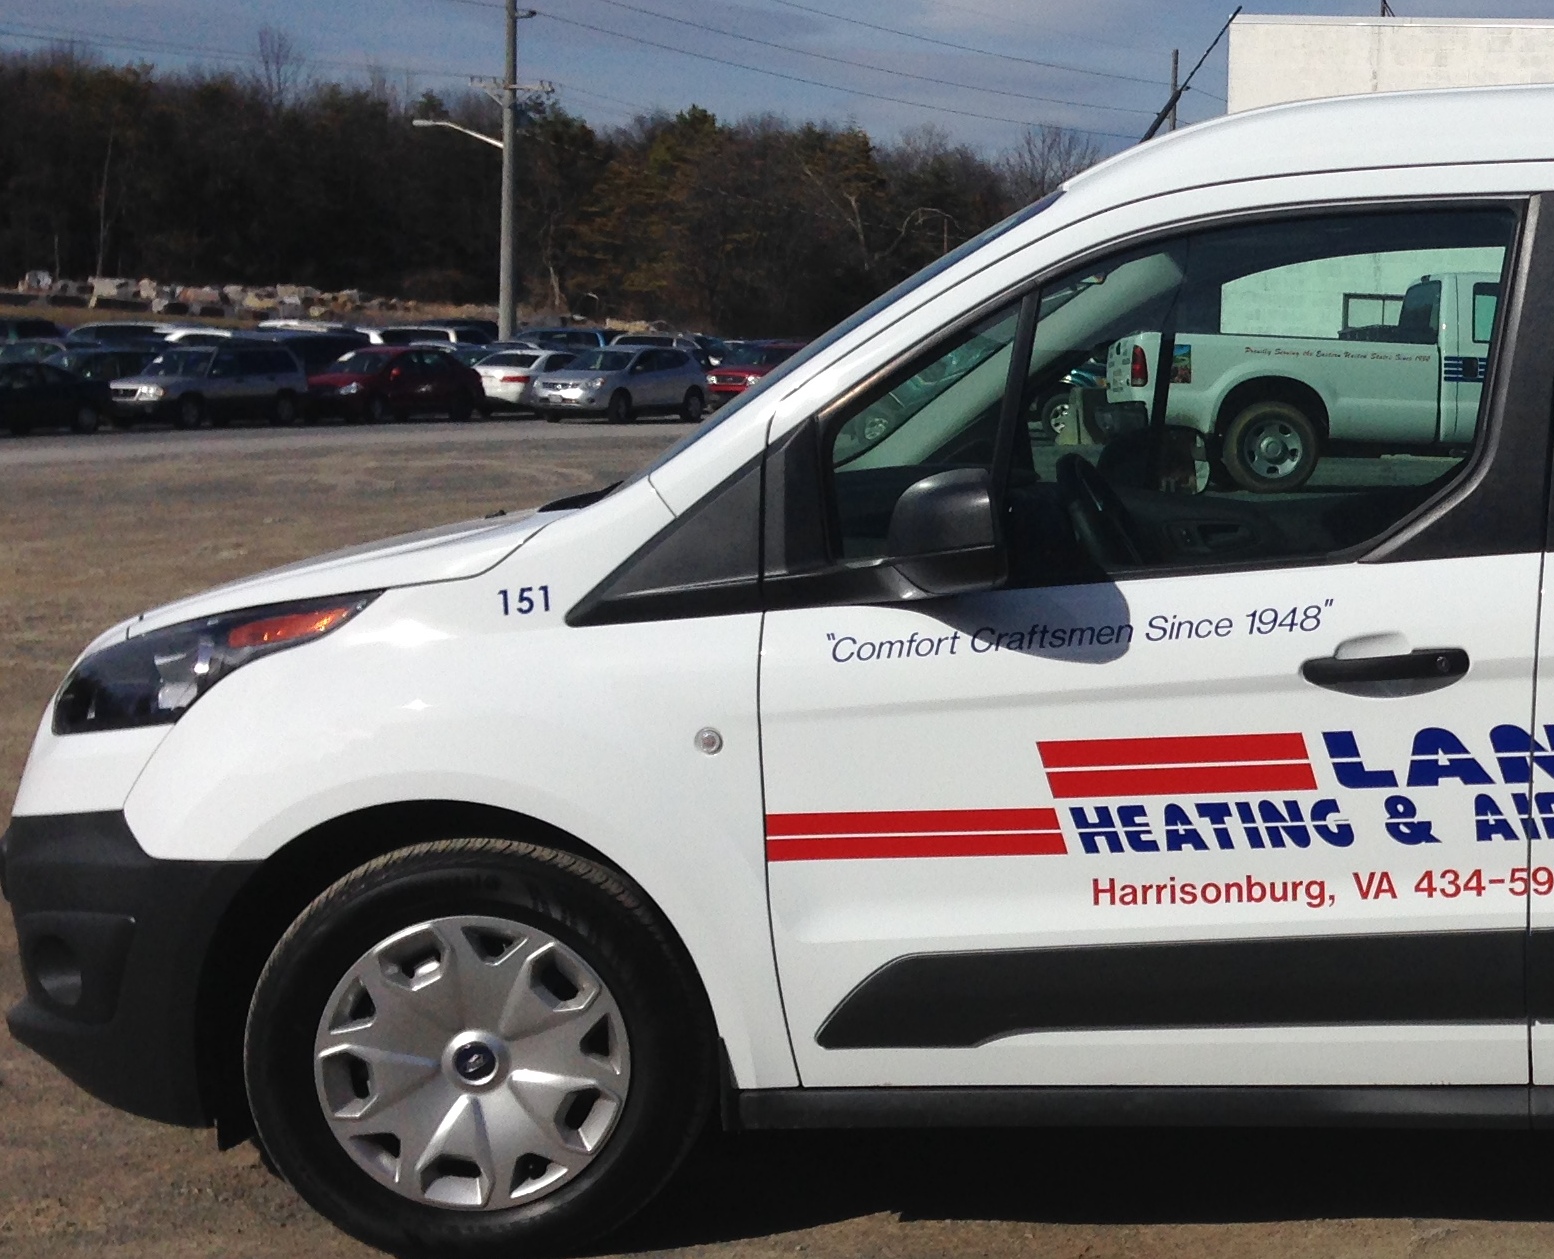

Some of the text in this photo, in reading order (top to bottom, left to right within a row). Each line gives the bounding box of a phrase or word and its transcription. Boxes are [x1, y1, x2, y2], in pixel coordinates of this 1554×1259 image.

[497, 585, 550, 616] 151
[827, 598, 1334, 663] "Comfort Craftsmen Since 1948"
[1069, 798, 1355, 855] HEATING
[1383, 794, 1442, 846] &
[1092, 874, 1336, 909] Harrisonburg,
[1352, 871, 1398, 900] VA
